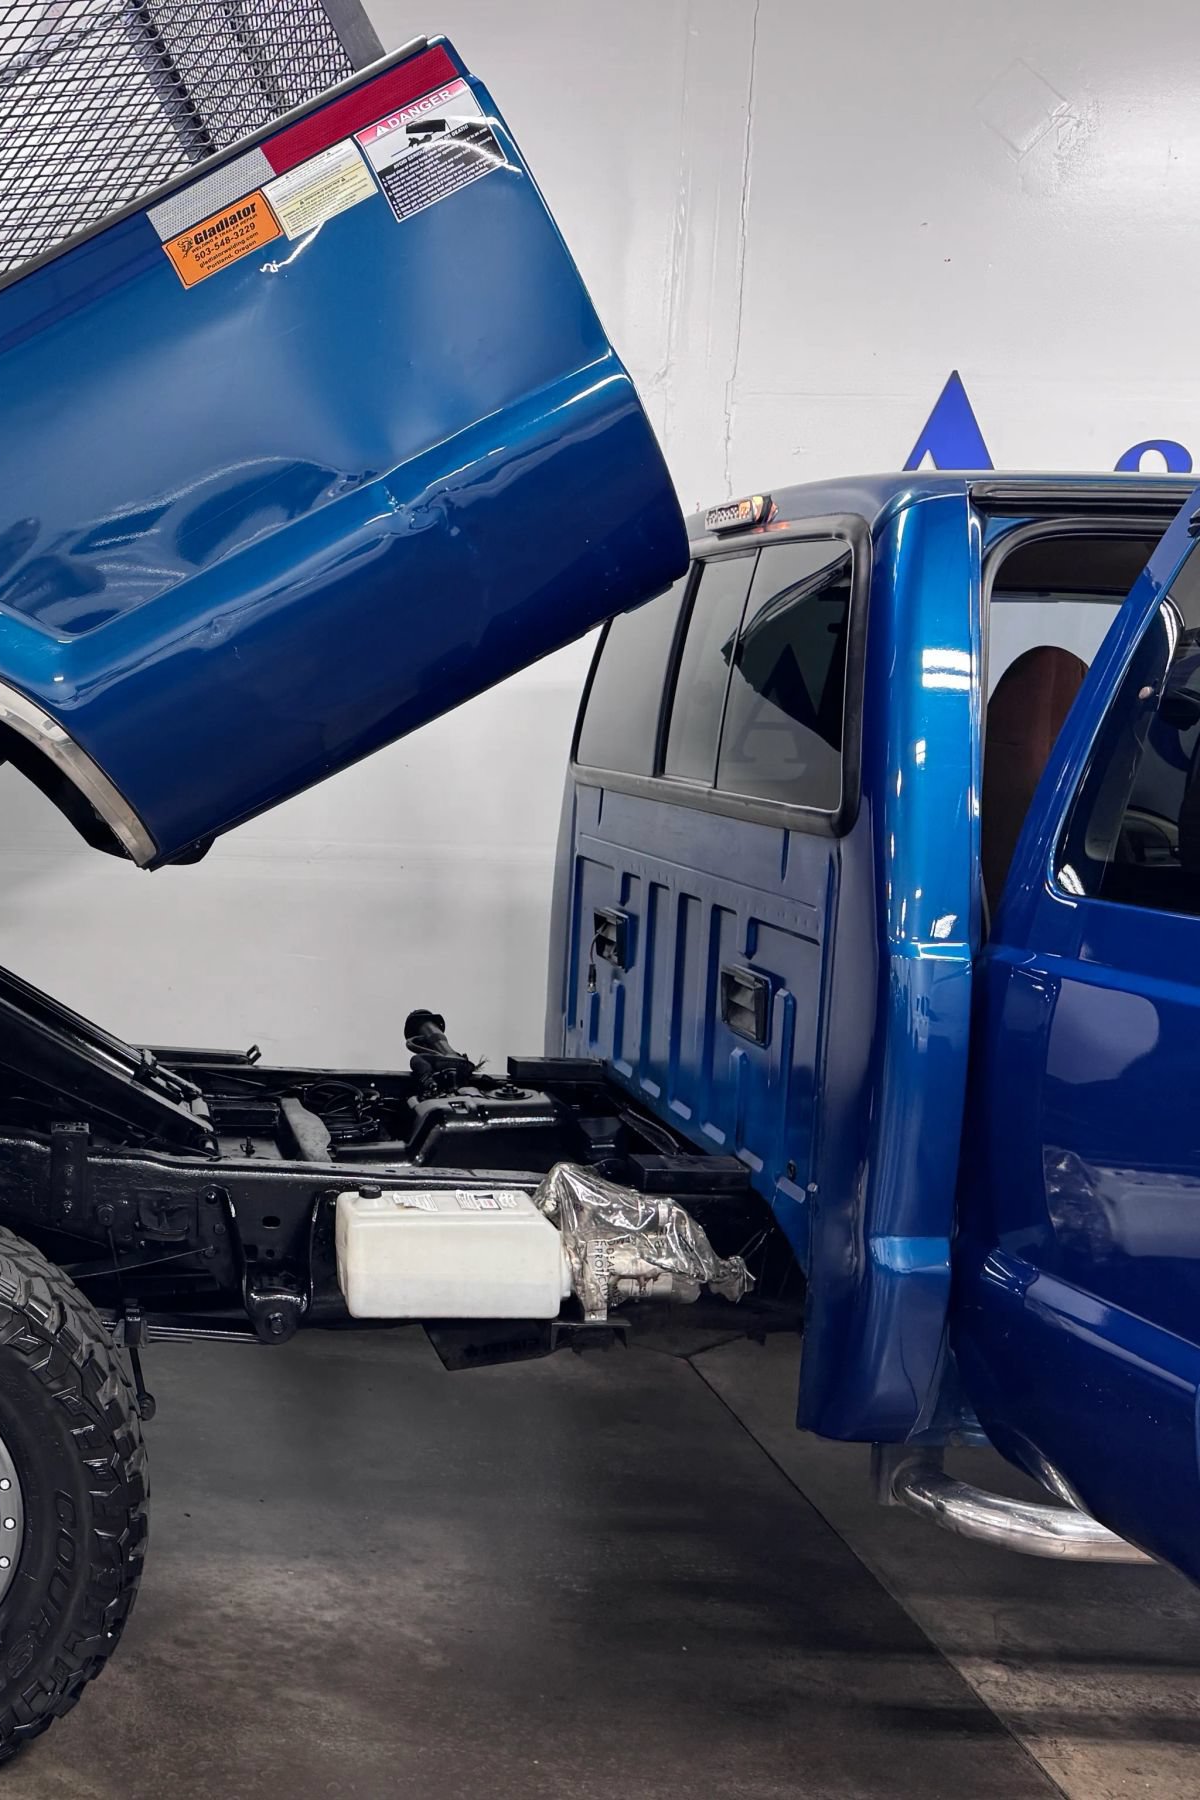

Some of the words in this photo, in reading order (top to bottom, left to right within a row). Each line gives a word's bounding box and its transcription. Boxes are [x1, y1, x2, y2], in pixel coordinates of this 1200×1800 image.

[387, 90, 452, 128] DANGER
[191, 239, 214, 253] WELDING
[219, 224, 240, 237] TRAILER
[194, 203, 256, 245] Gladiator
[194, 222, 256, 262] 503-548-3229
[199, 231, 259, 269] gladiatorwelding.com
[206, 253, 233, 270] Portland,
[234, 240, 256, 255] Oregon
